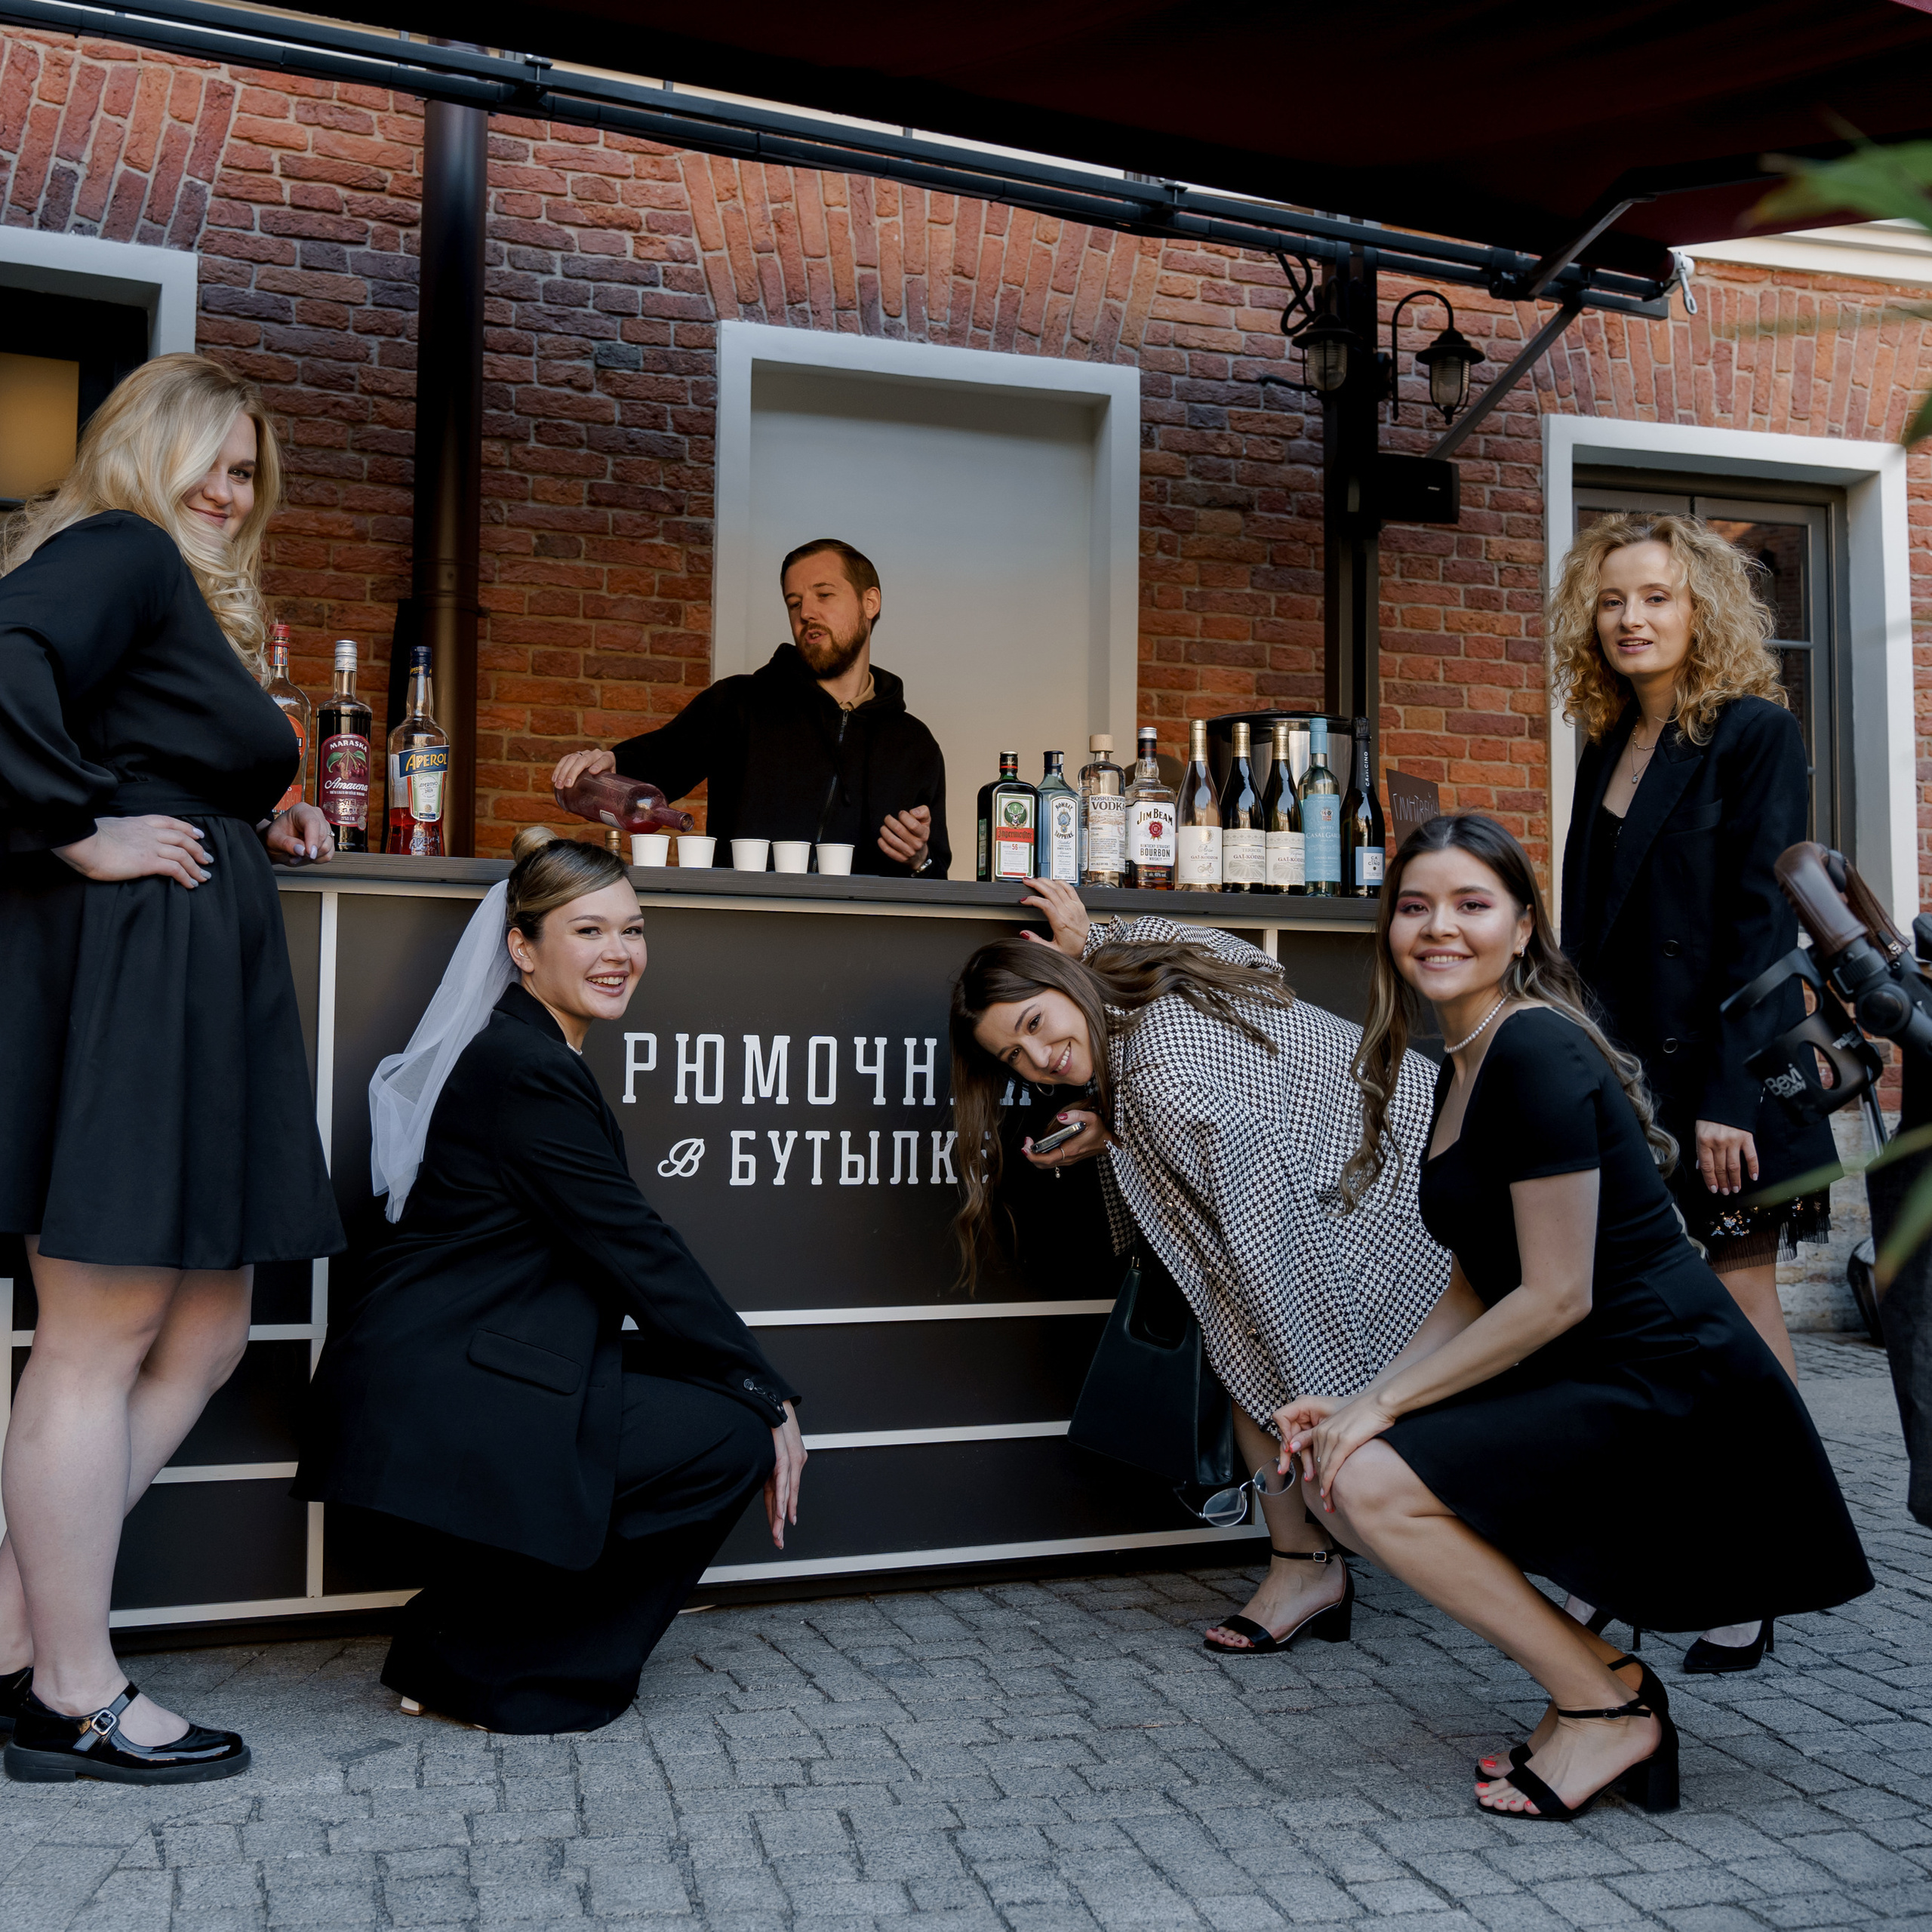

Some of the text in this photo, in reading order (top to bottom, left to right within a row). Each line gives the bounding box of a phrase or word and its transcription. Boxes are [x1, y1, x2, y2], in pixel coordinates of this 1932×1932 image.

[330, 740, 368, 752] MARASKA
[405, 753, 447, 772] APEROL
[325, 777, 368, 792] Amarena
[1055, 802, 1073, 811] BOMBAY
[1137, 808, 1173, 826] JIM BEAM
[1140, 848, 1171, 857] BOURBON
[1764, 1063, 1803, 1096] Bevi
[729, 1131, 990, 1186] БУТЫЛК
